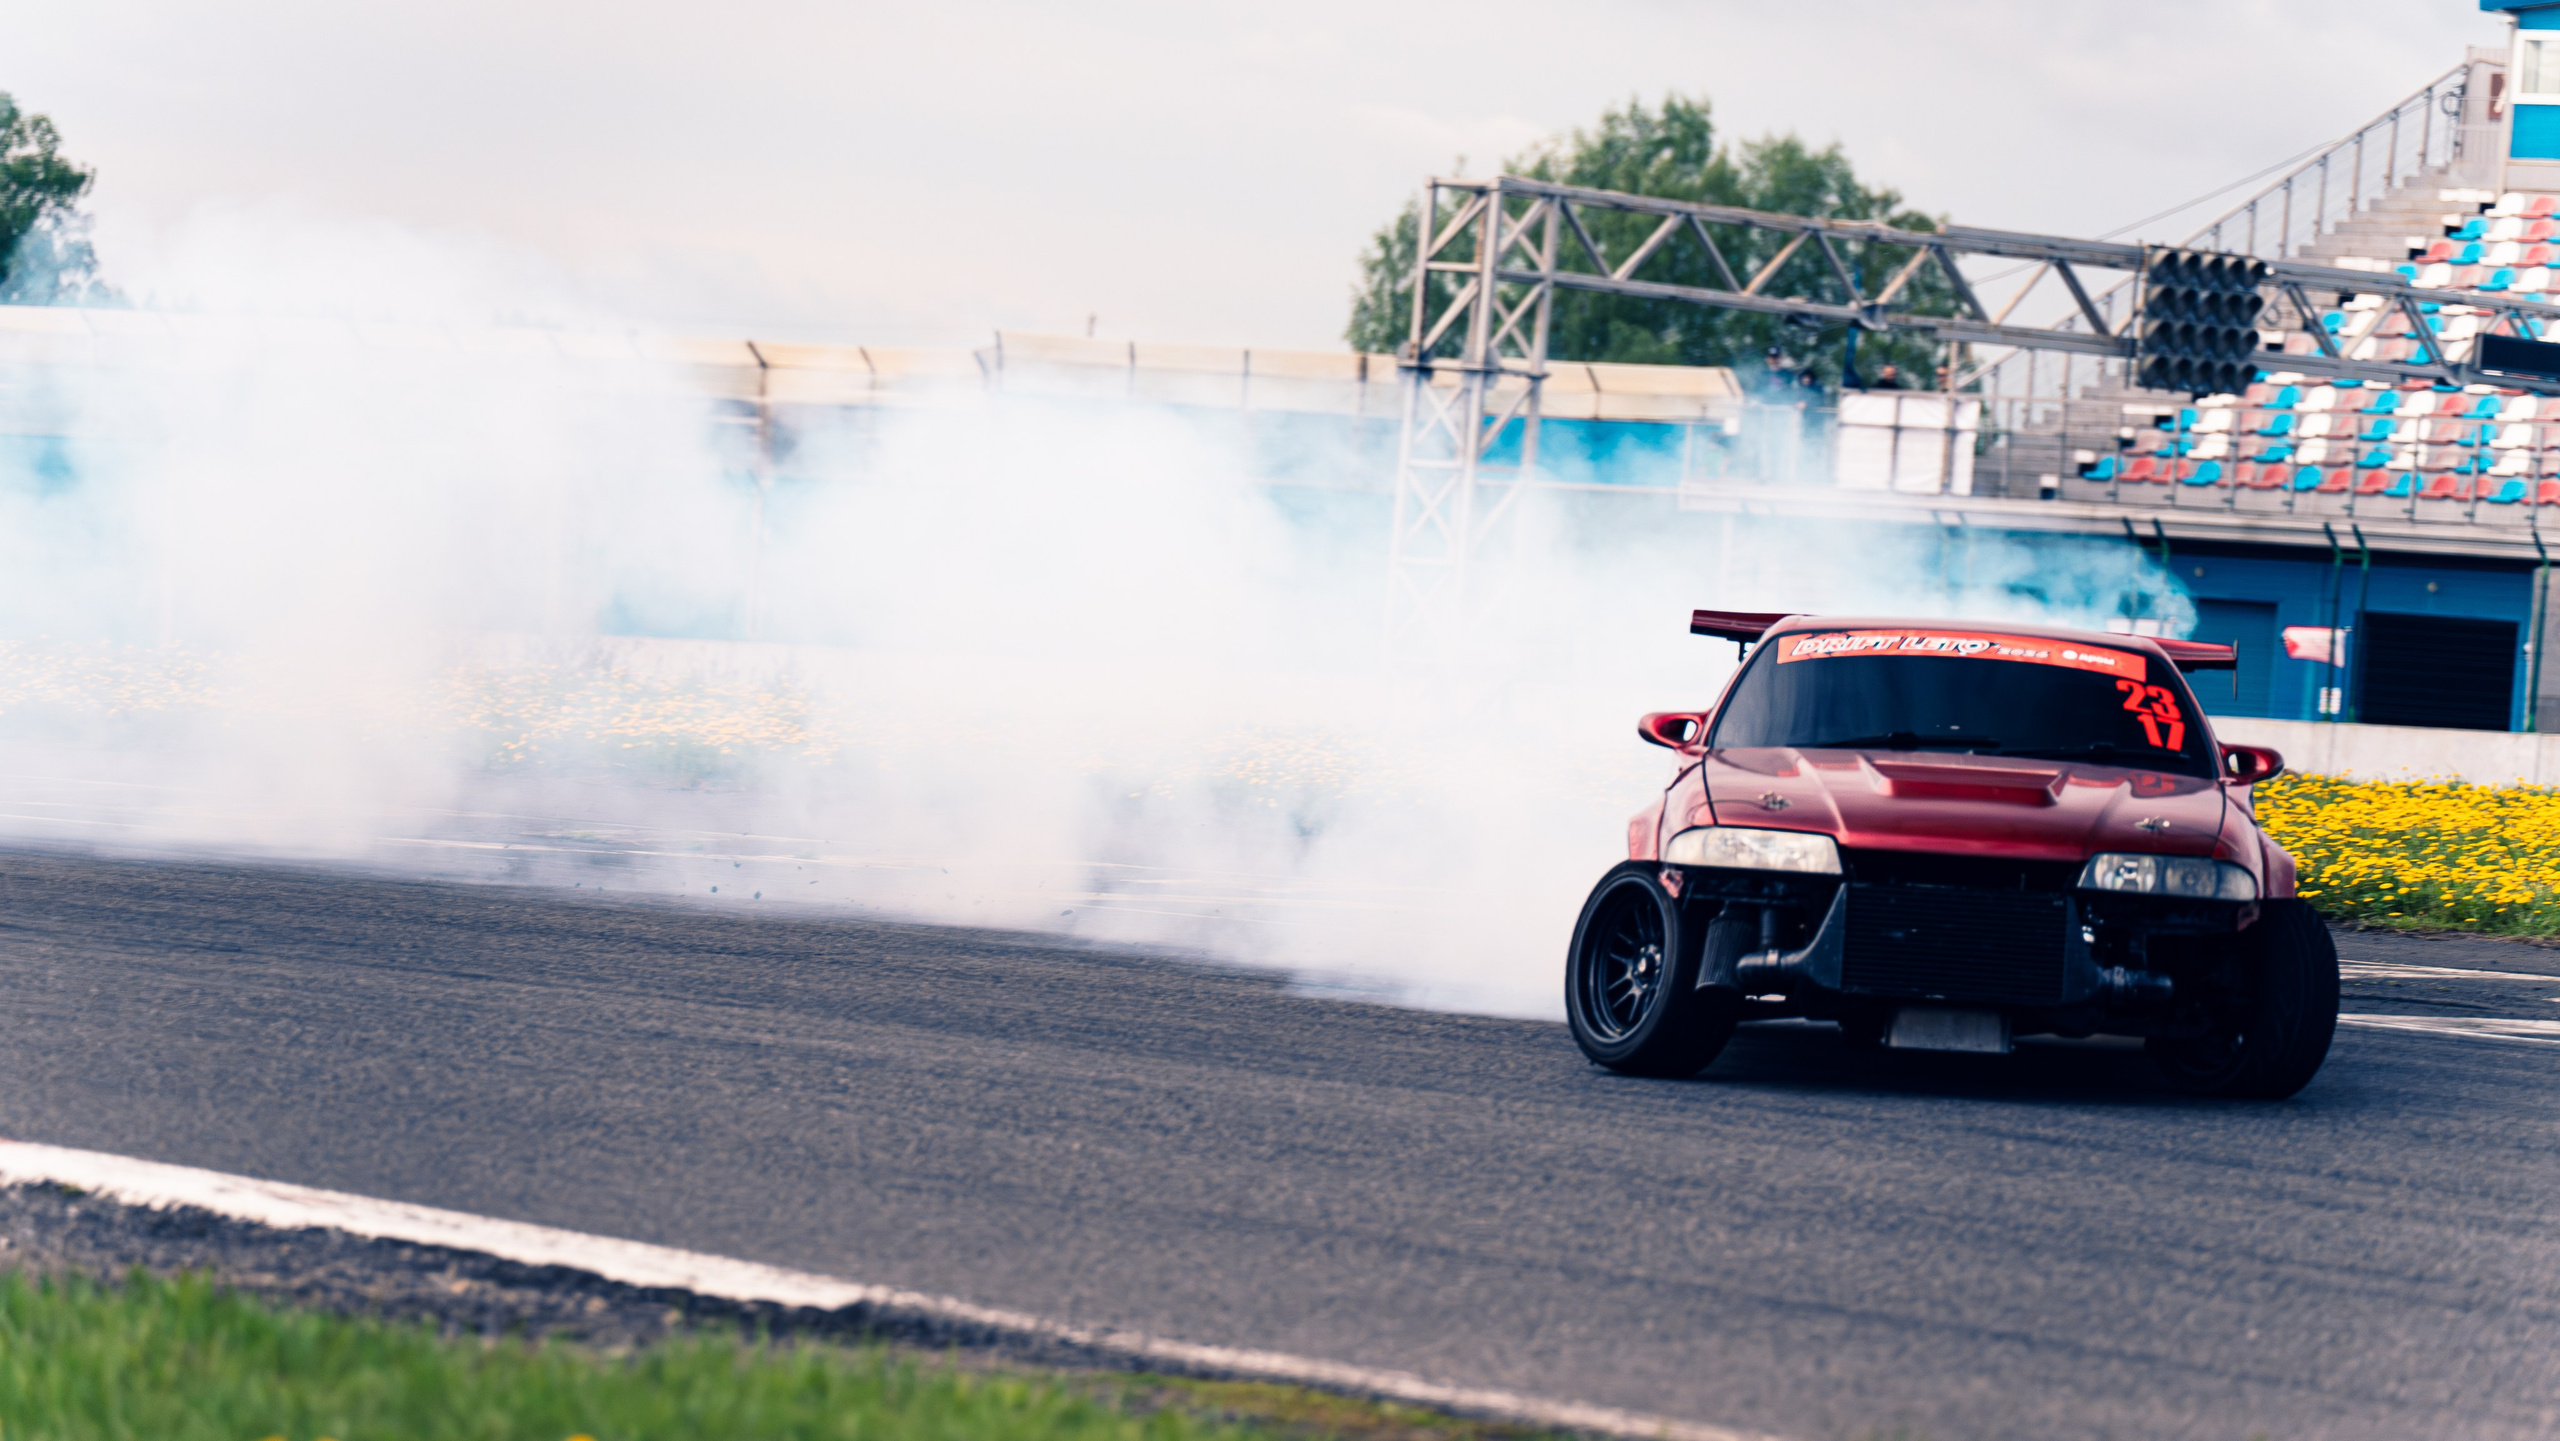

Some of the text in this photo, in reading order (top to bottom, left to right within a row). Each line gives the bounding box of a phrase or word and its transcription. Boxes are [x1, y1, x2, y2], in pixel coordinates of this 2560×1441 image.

[1791, 635, 1901, 656] DRIFT
[1899, 635, 1990, 656] LETO
[2115, 679, 2181, 720] 23
[2136, 713, 2185, 752] 17
